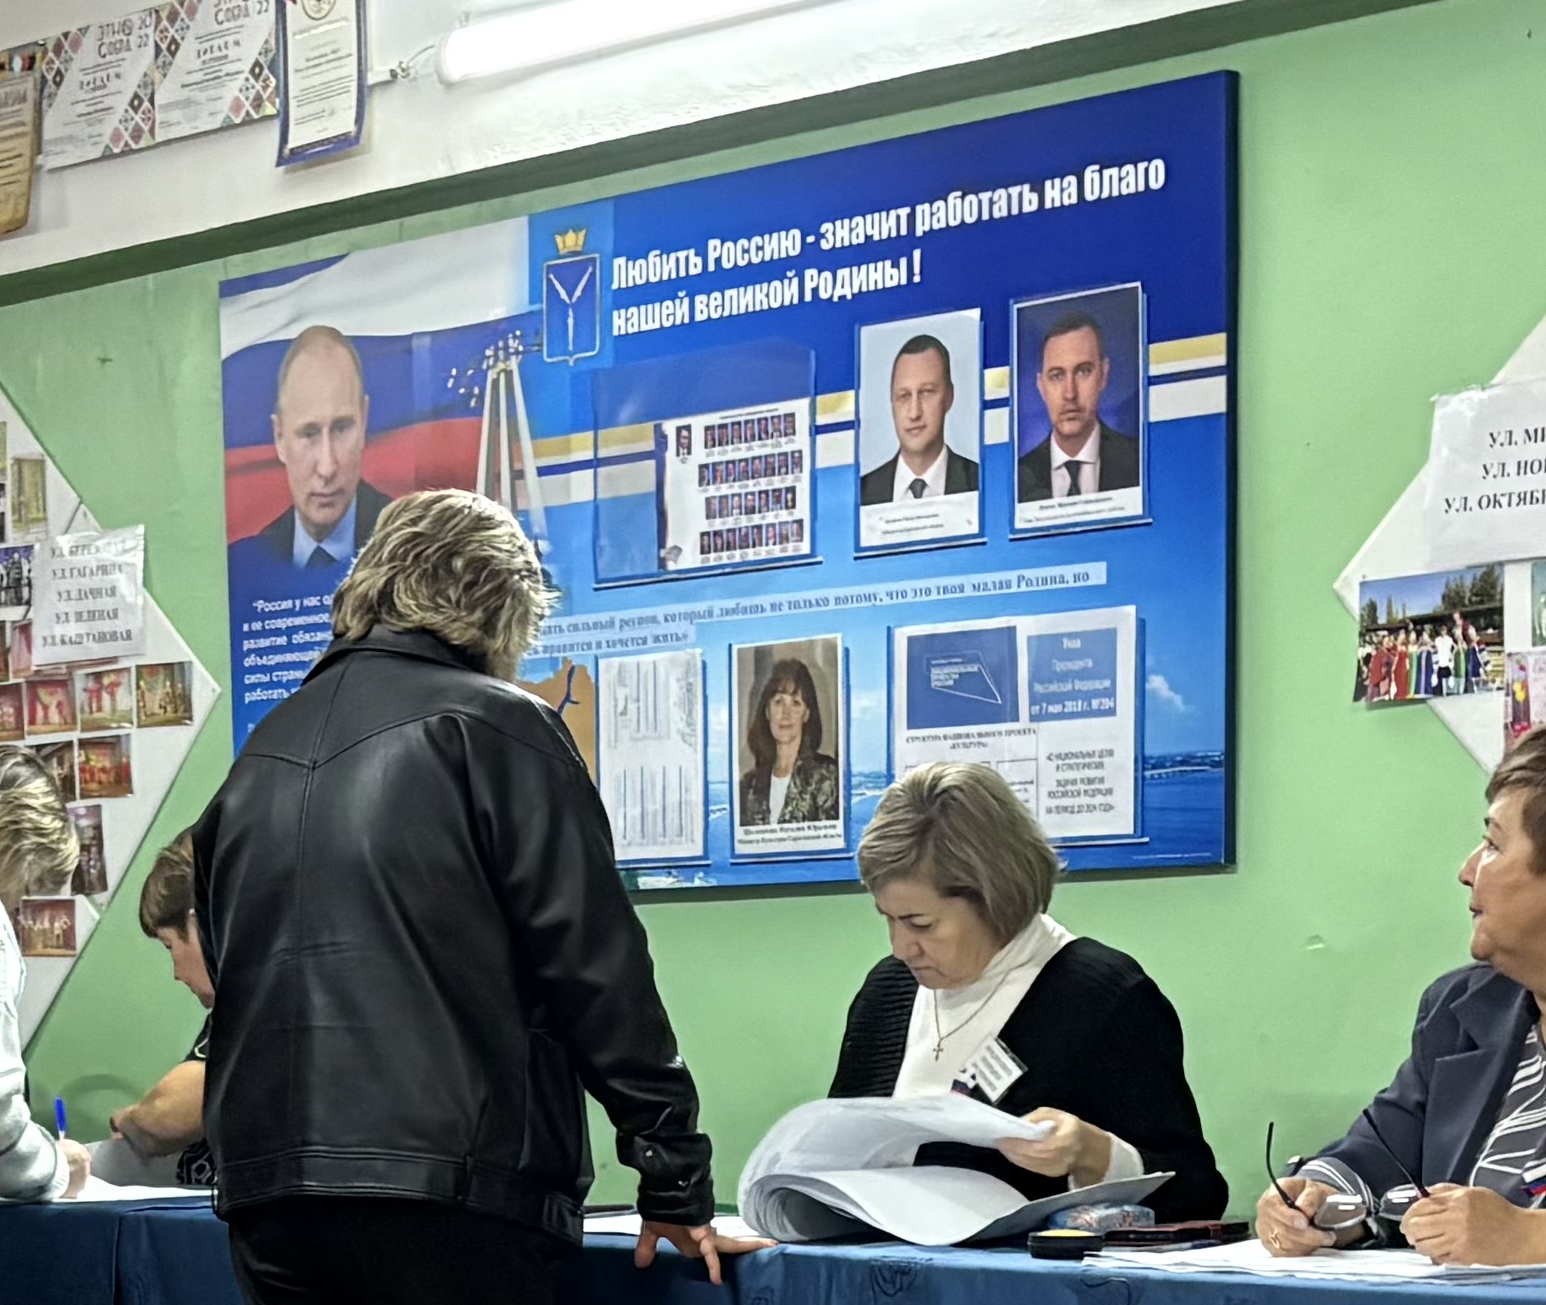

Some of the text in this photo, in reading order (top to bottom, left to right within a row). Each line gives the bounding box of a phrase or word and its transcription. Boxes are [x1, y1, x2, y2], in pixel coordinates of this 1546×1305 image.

[612, 249, 703, 290] Любить
[708, 228, 802, 272] Россию
[820, 206, 912, 251] значит
[915, 176, 1040, 236] работать
[1043, 172, 1079, 207] на
[1083, 157, 1167, 202] благо
[612, 249, 923, 337] нашей великой Родины !
[1488, 429, 1519, 449] УЛ.
[1481, 462, 1512, 481] УЛ.
[1444, 497, 1474, 515] УЛ.
[302, 595, 321, 608] нас
[567, 616, 616, 634] сильный
[618, 613, 661, 633] регион,
[663, 606, 714, 625] который
[769, 599, 784, 613] не
[787, 597, 830, 611] только
[833, 592, 883, 608] потому,
[886, 588, 908, 601] что
[912, 586, 932, 599] это
[935, 583, 966, 596] твоя
[971, 578, 1013, 592] малая
[1016, 574, 1070, 590] Родина,
[1073, 571, 1090, 584] но
[605, 634, 648, 649] хочется
